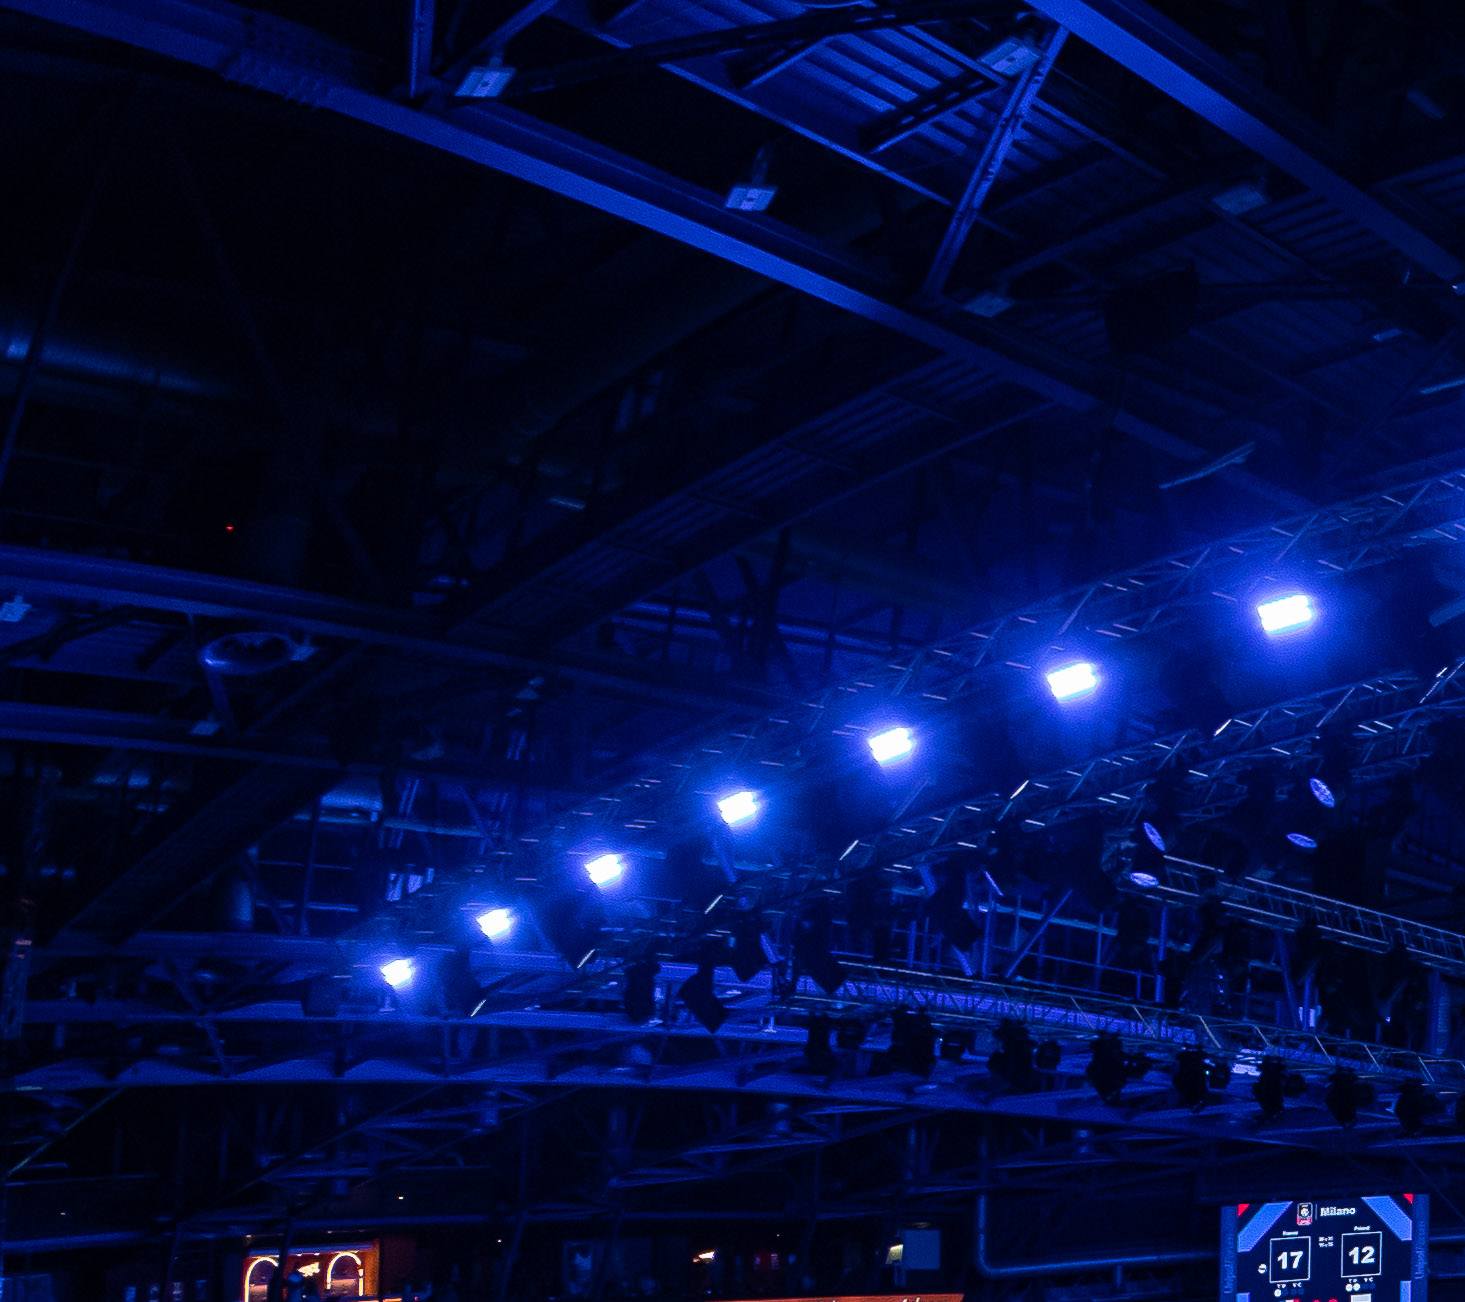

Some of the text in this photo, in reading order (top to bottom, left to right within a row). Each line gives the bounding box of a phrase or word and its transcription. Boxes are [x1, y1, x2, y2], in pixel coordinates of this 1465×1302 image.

[1320, 1207, 1356, 1217] Milano
[1277, 1250, 1303, 1269] 17
[1348, 1246, 1375, 1264] 12
